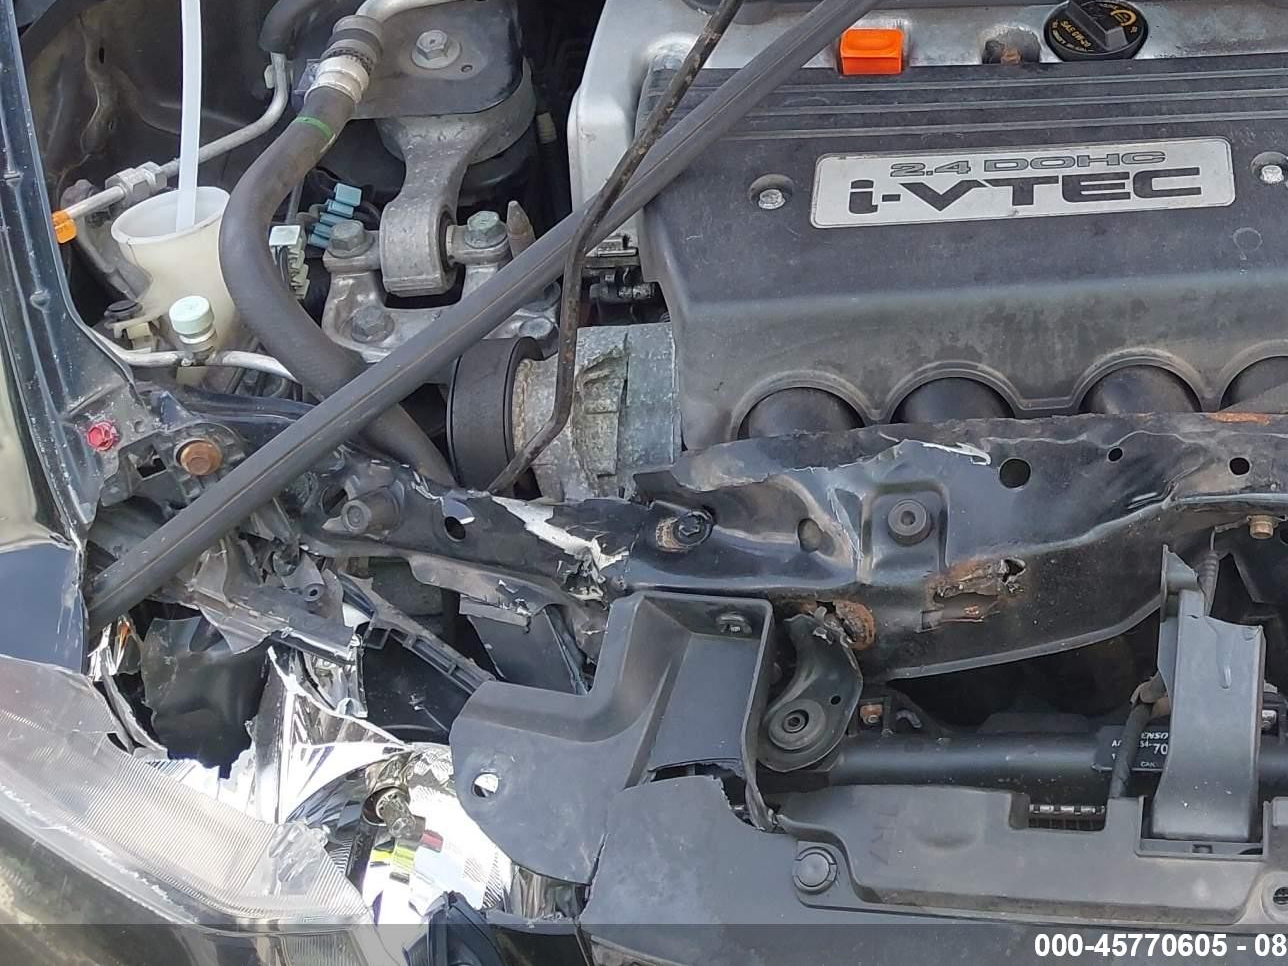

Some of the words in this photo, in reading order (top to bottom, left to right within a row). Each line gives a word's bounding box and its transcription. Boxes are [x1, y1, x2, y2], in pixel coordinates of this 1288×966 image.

[890, 160, 971, 177] 2.4
[983, 151, 1166, 172] DOHC
[848, 167, 1202, 215] i-VTEC
